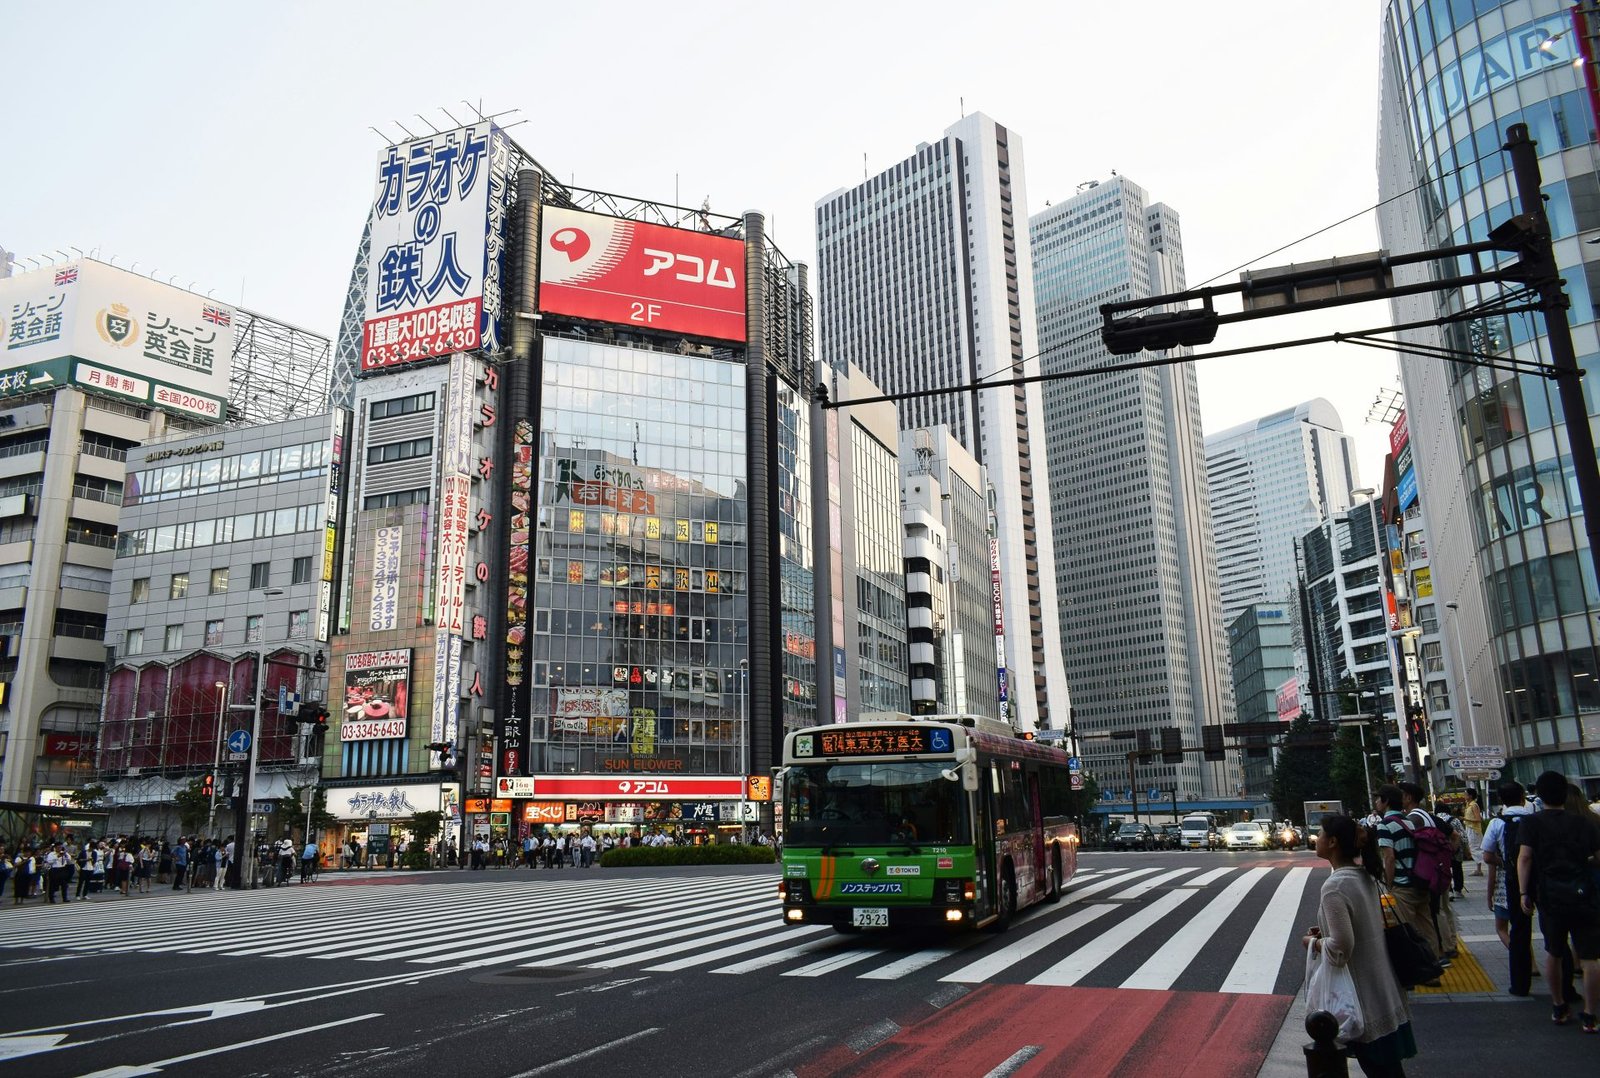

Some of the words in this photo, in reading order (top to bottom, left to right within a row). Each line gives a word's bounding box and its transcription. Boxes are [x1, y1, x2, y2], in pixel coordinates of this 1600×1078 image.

[376, 128, 487, 219] カラオケ
[414, 201, 442, 245] の
[481, 133, 508, 352] カラオケの鉄人
[377, 232, 471, 312] 鉄人
[643, 248, 737, 289] アコム
[12, 293, 66, 320] シェーン
[630, 302, 662, 323] 2F
[9, 311, 63, 342] 英会話
[147, 312, 216, 343] シェーン
[368, 302, 477, 348] 1室最大100名収容
[144, 330, 214, 369] 英会話
[88, 370, 135, 394] 月謝制
[157, 389, 217, 415] 全国200校
[449, 478, 469, 631] 100名収容大パーティールーム
[845, 736, 923, 750] 東京女子医大
[605, 759, 630, 770] SUN
[634, 759, 683, 770] FLOWER
[634, 781, 669, 793] アコム
[347, 788, 416, 815] カラオケの鉄人
[526, 805, 562, 819] 宝くじ
[841, 883, 902, 893] ノンステップバス
[859, 914, 887, 926] 29-23
